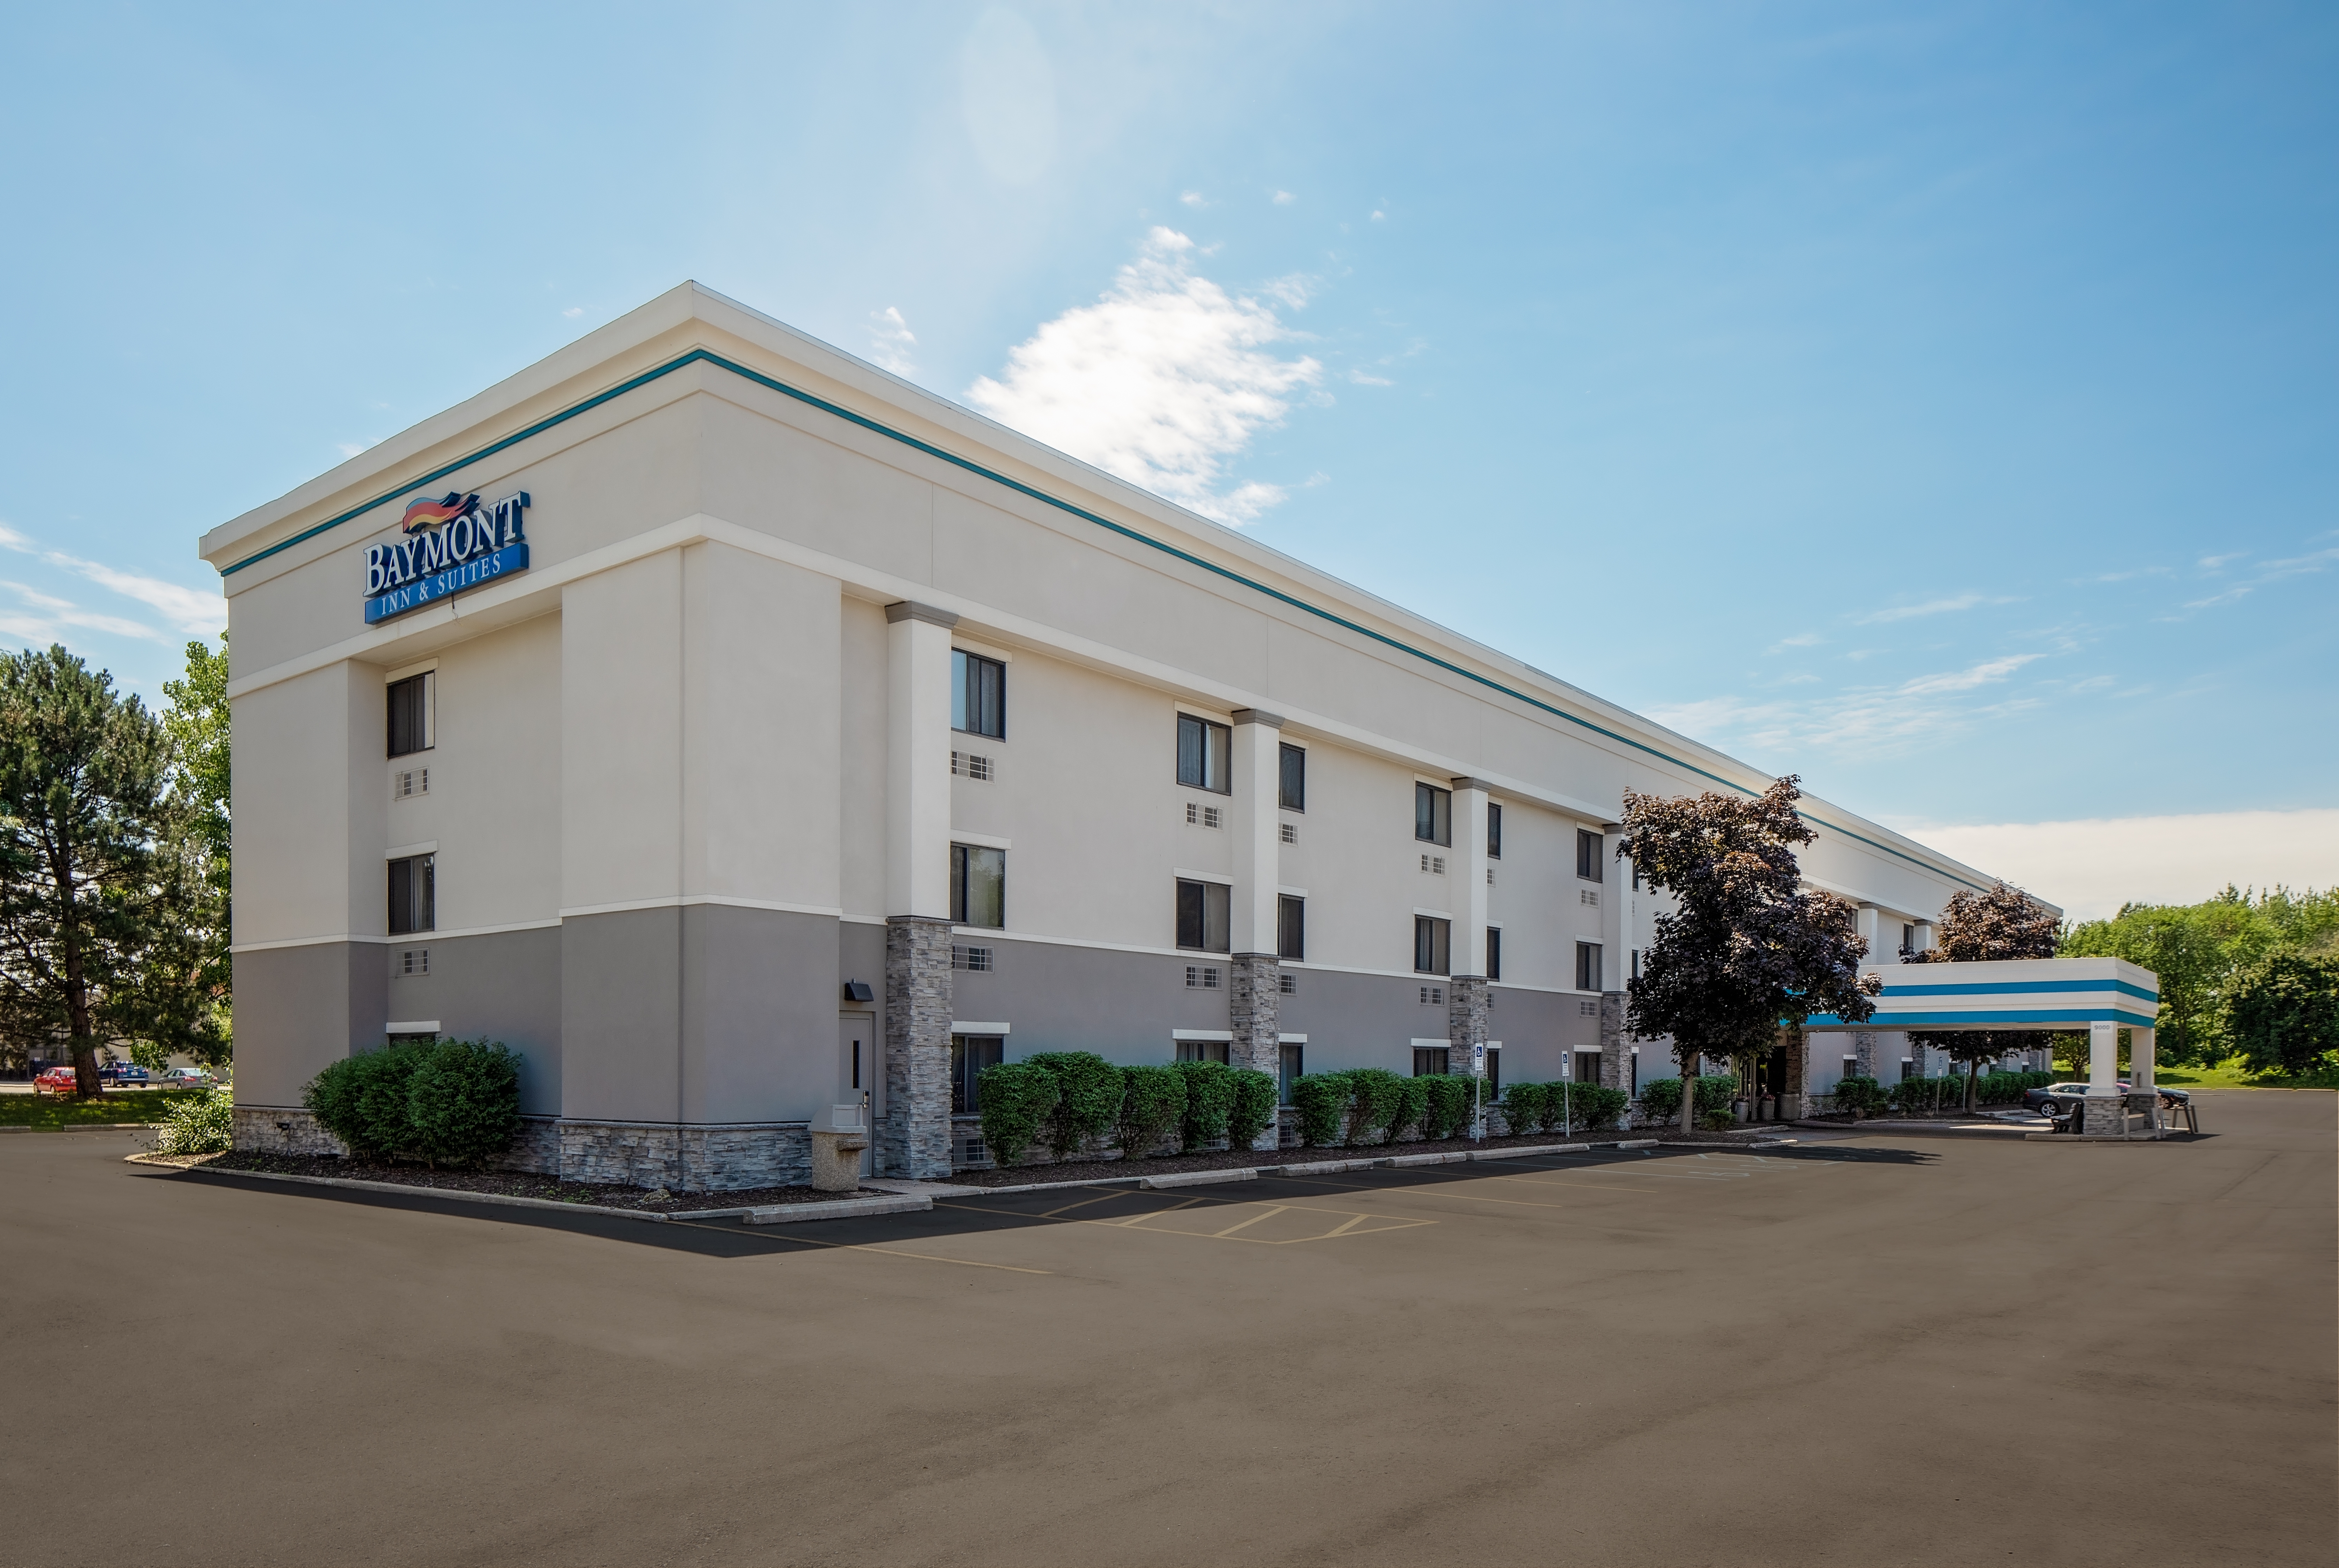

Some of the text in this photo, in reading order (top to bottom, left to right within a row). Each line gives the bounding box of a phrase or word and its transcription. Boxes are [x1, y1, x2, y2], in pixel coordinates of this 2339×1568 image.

[363, 490, 522, 597] BAYMONT
[382, 553, 500, 615] INN & SUITES
